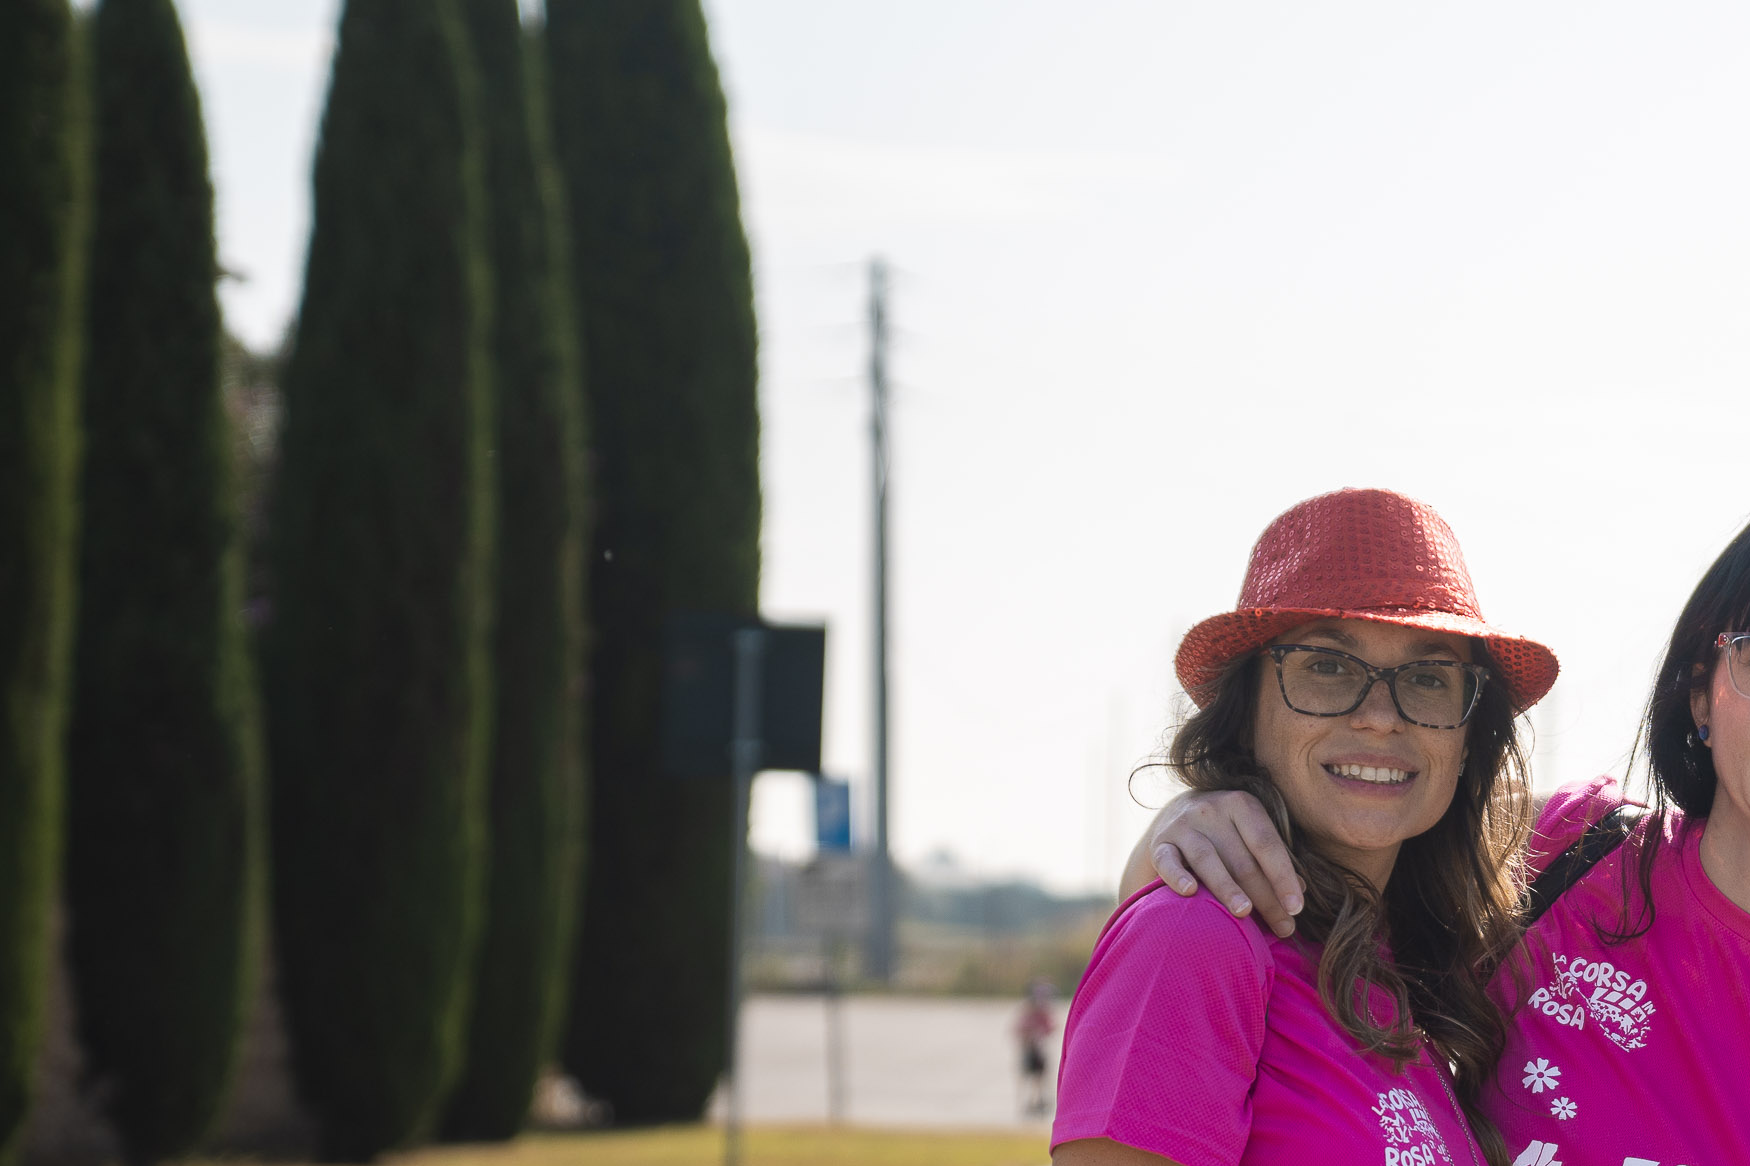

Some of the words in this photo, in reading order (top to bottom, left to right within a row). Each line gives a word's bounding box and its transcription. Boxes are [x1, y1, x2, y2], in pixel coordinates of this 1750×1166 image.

[1528, 987, 1585, 1030] ROSA
[1552, 952, 1567, 965] LA
[1569, 957, 1648, 1002] CORSA
[1641, 1000, 1657, 1015] IN
